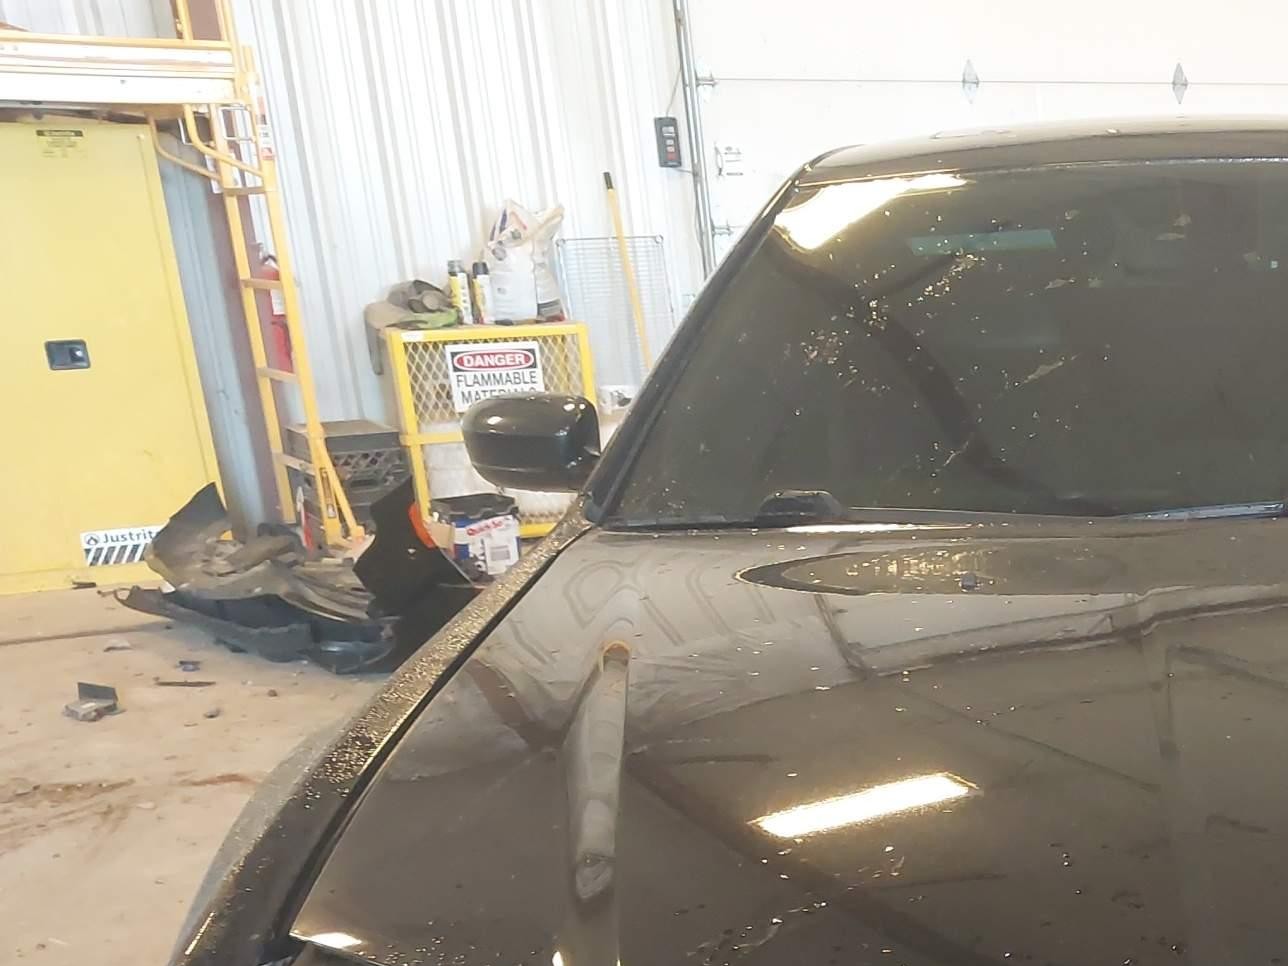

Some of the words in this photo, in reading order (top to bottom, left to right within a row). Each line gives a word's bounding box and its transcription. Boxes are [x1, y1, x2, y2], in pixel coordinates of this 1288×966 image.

[463, 353, 526, 368] DANGER
[456, 371, 538, 387] FLAMMABLE
[103, 529, 157, 544] Justrit
